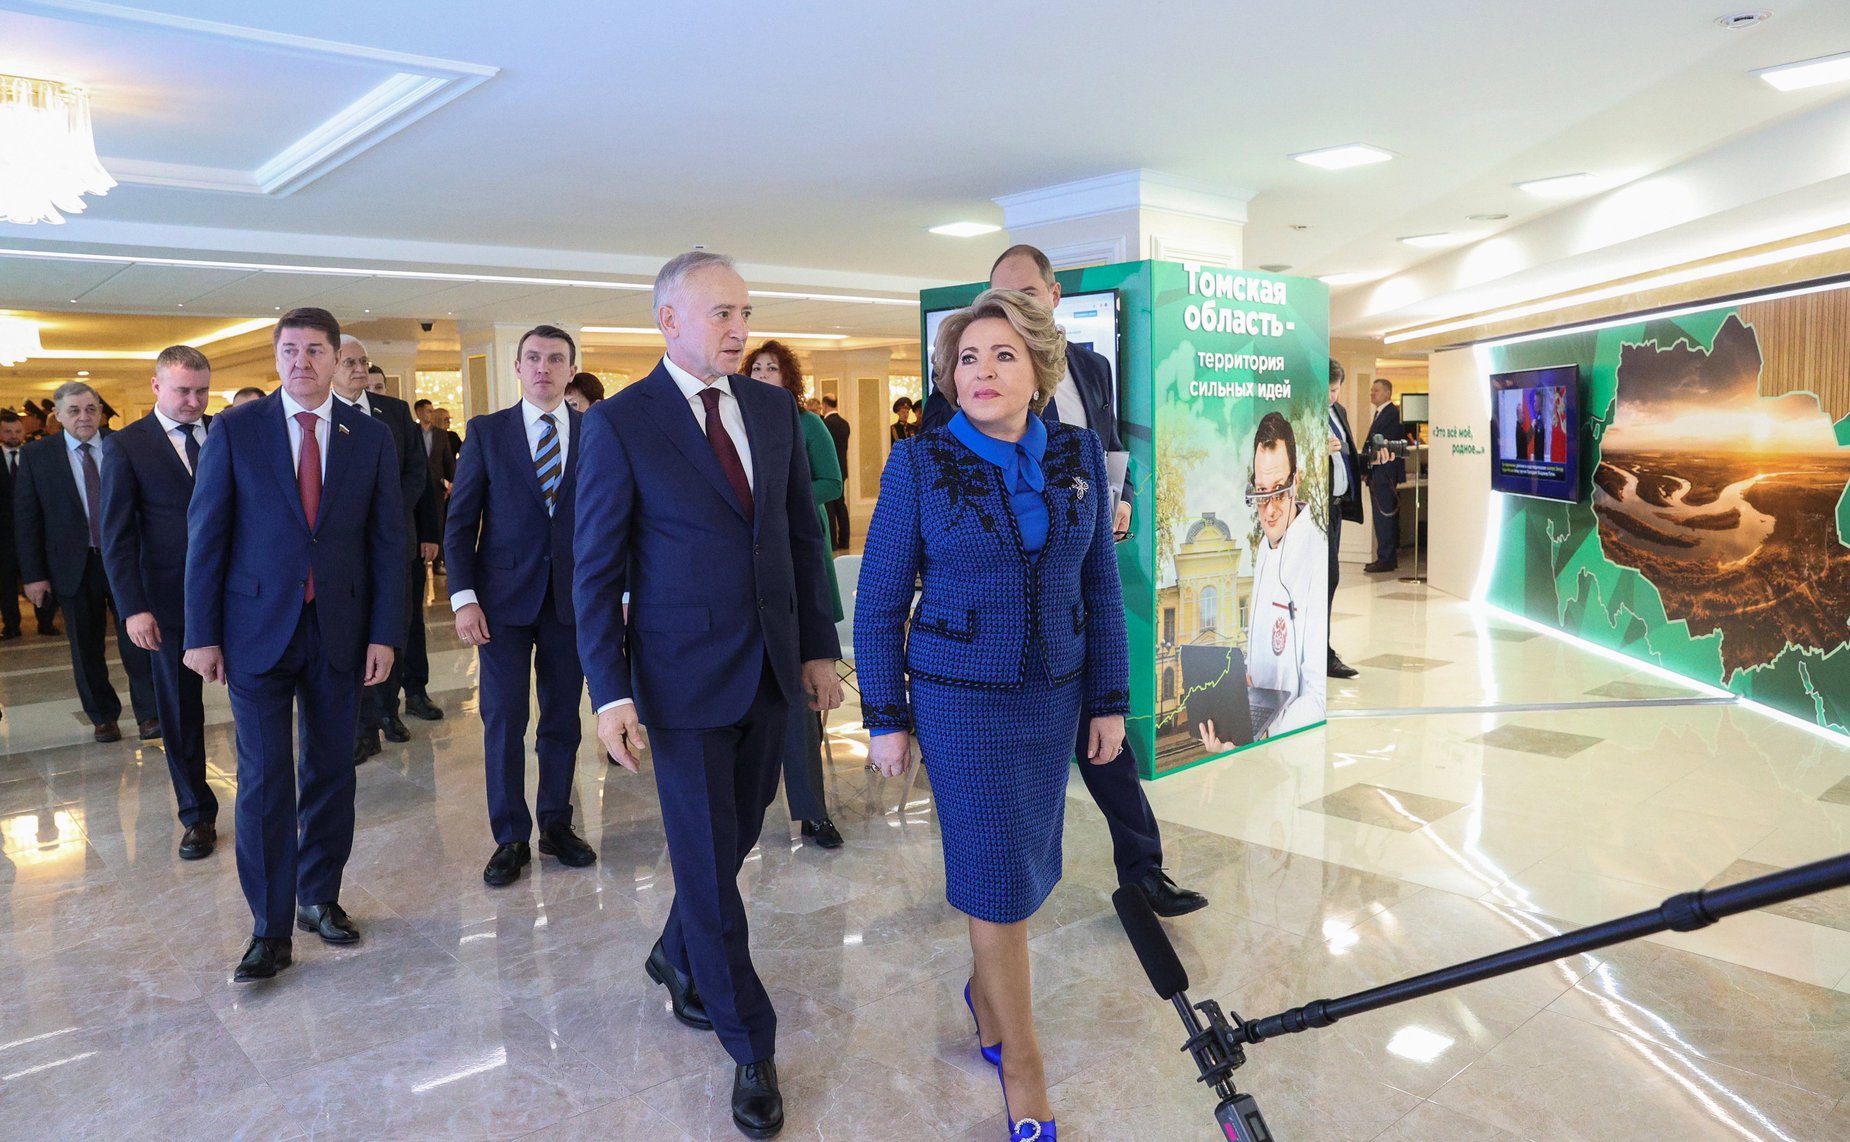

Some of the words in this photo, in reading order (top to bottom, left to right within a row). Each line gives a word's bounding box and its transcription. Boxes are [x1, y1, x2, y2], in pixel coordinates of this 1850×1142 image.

[1183, 262, 1287, 305] Томская
[1198, 352, 1285, 374] территория
[1190, 380, 1254, 398] сильных
[1258, 379, 1291, 400] идей
